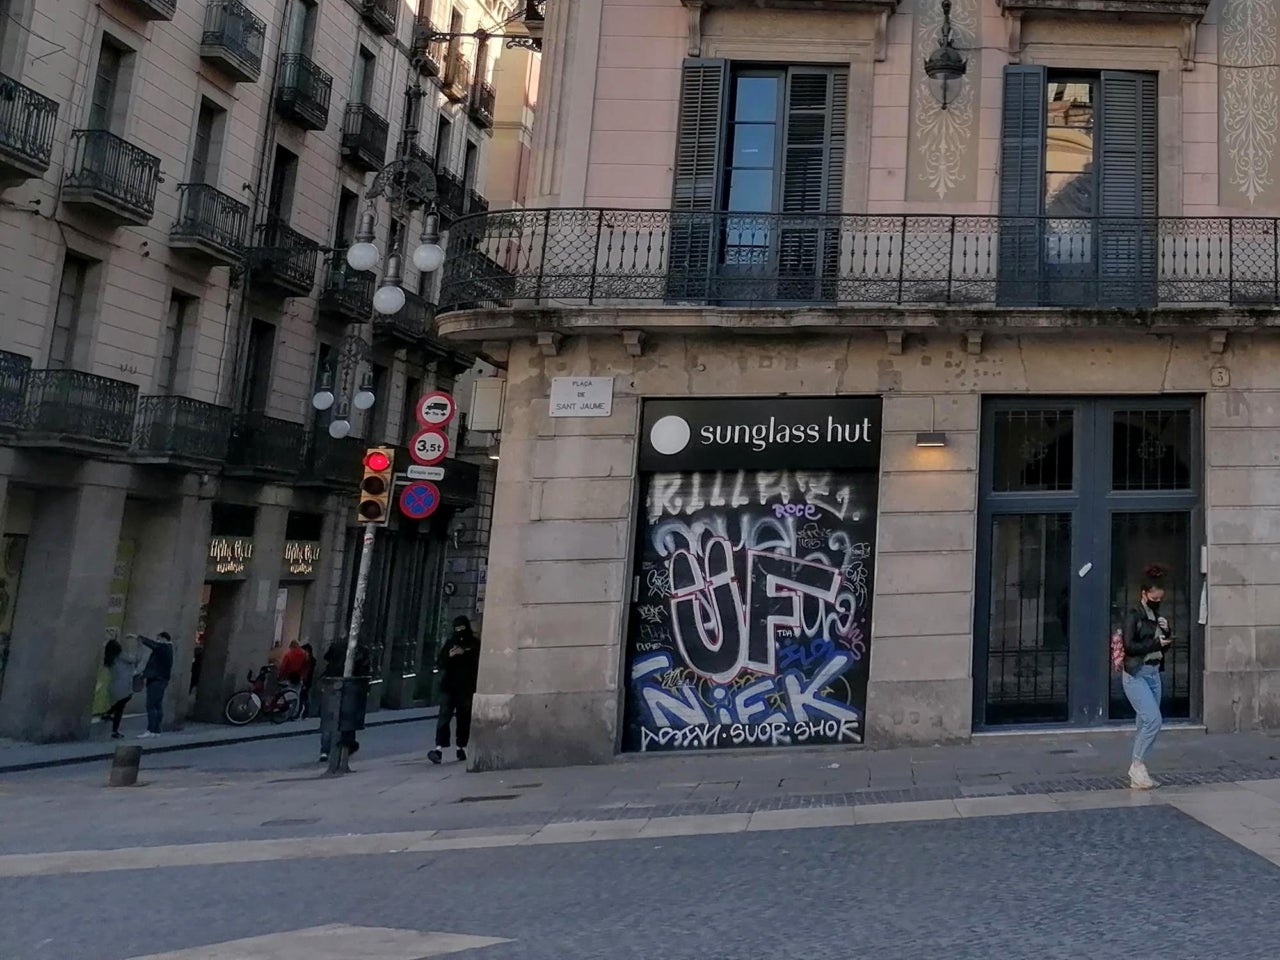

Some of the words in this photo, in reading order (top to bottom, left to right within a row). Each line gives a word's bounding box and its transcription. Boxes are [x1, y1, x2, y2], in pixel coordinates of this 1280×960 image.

[556, 402, 576, 411] SANT
[580, 402, 606, 410] JAUME
[700, 416, 820, 452] sunglass
[827, 415, 872, 443] hut
